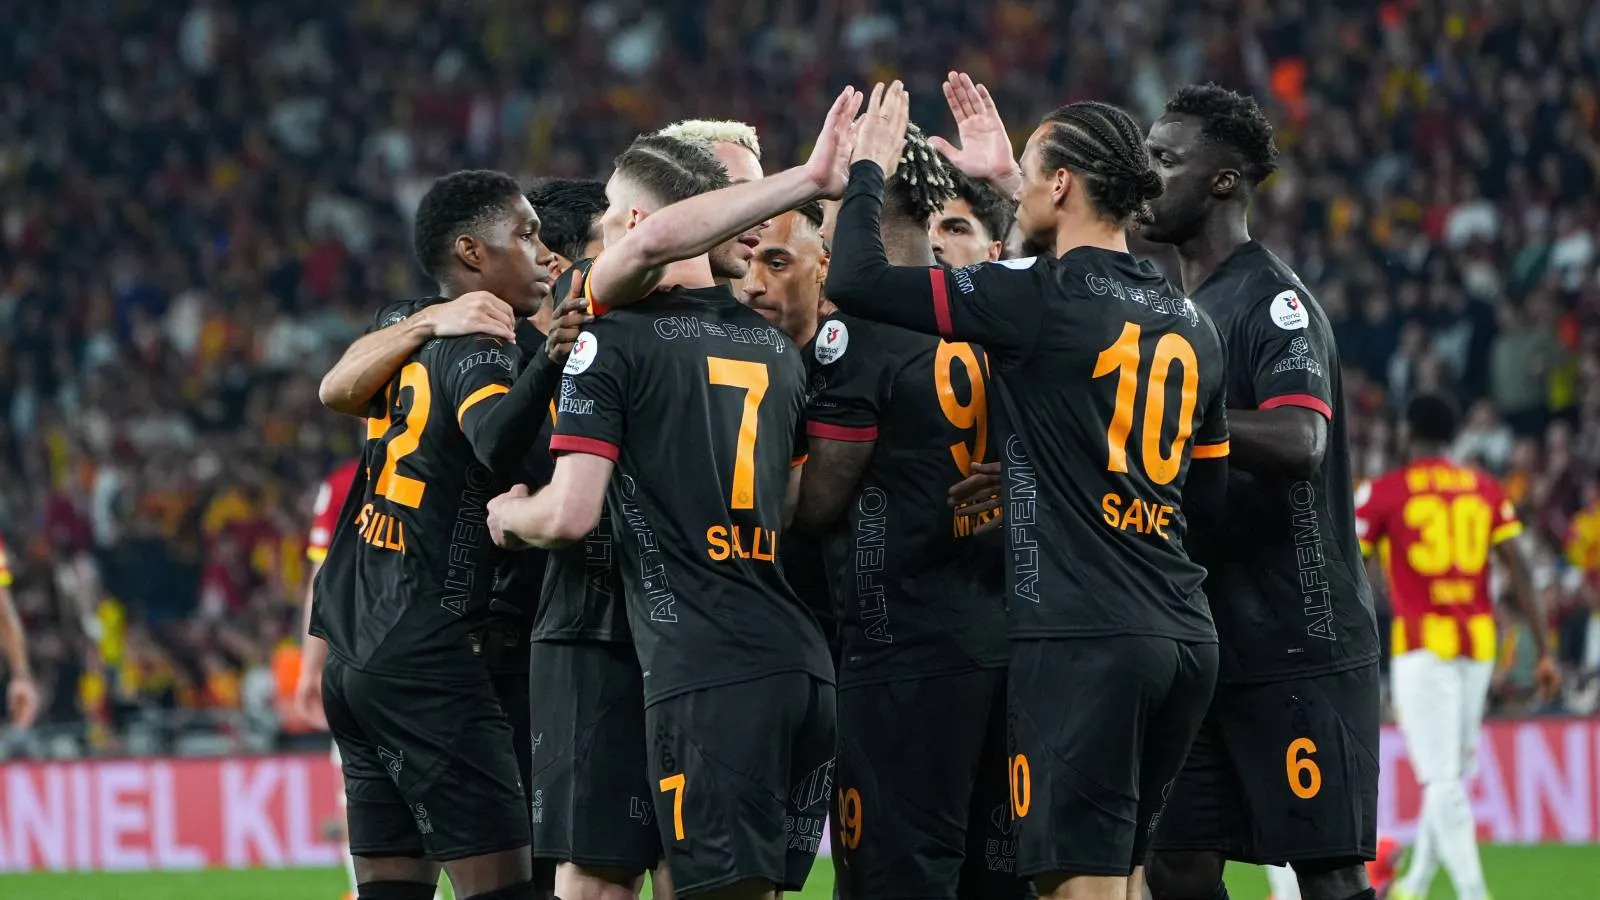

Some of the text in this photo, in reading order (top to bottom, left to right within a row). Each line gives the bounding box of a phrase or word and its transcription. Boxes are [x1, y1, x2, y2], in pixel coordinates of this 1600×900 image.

[458, 348, 514, 374] mis
[653, 316, 701, 340] CW
[558, 397, 594, 415] HAM
[707, 356, 769, 510] 7
[1092, 321, 1200, 486] 10
[1404, 493, 1493, 575] 30
[1286, 737, 1322, 799] 6
[0, 757, 344, 872] NIEL KL
[659, 773, 686, 841] 7
